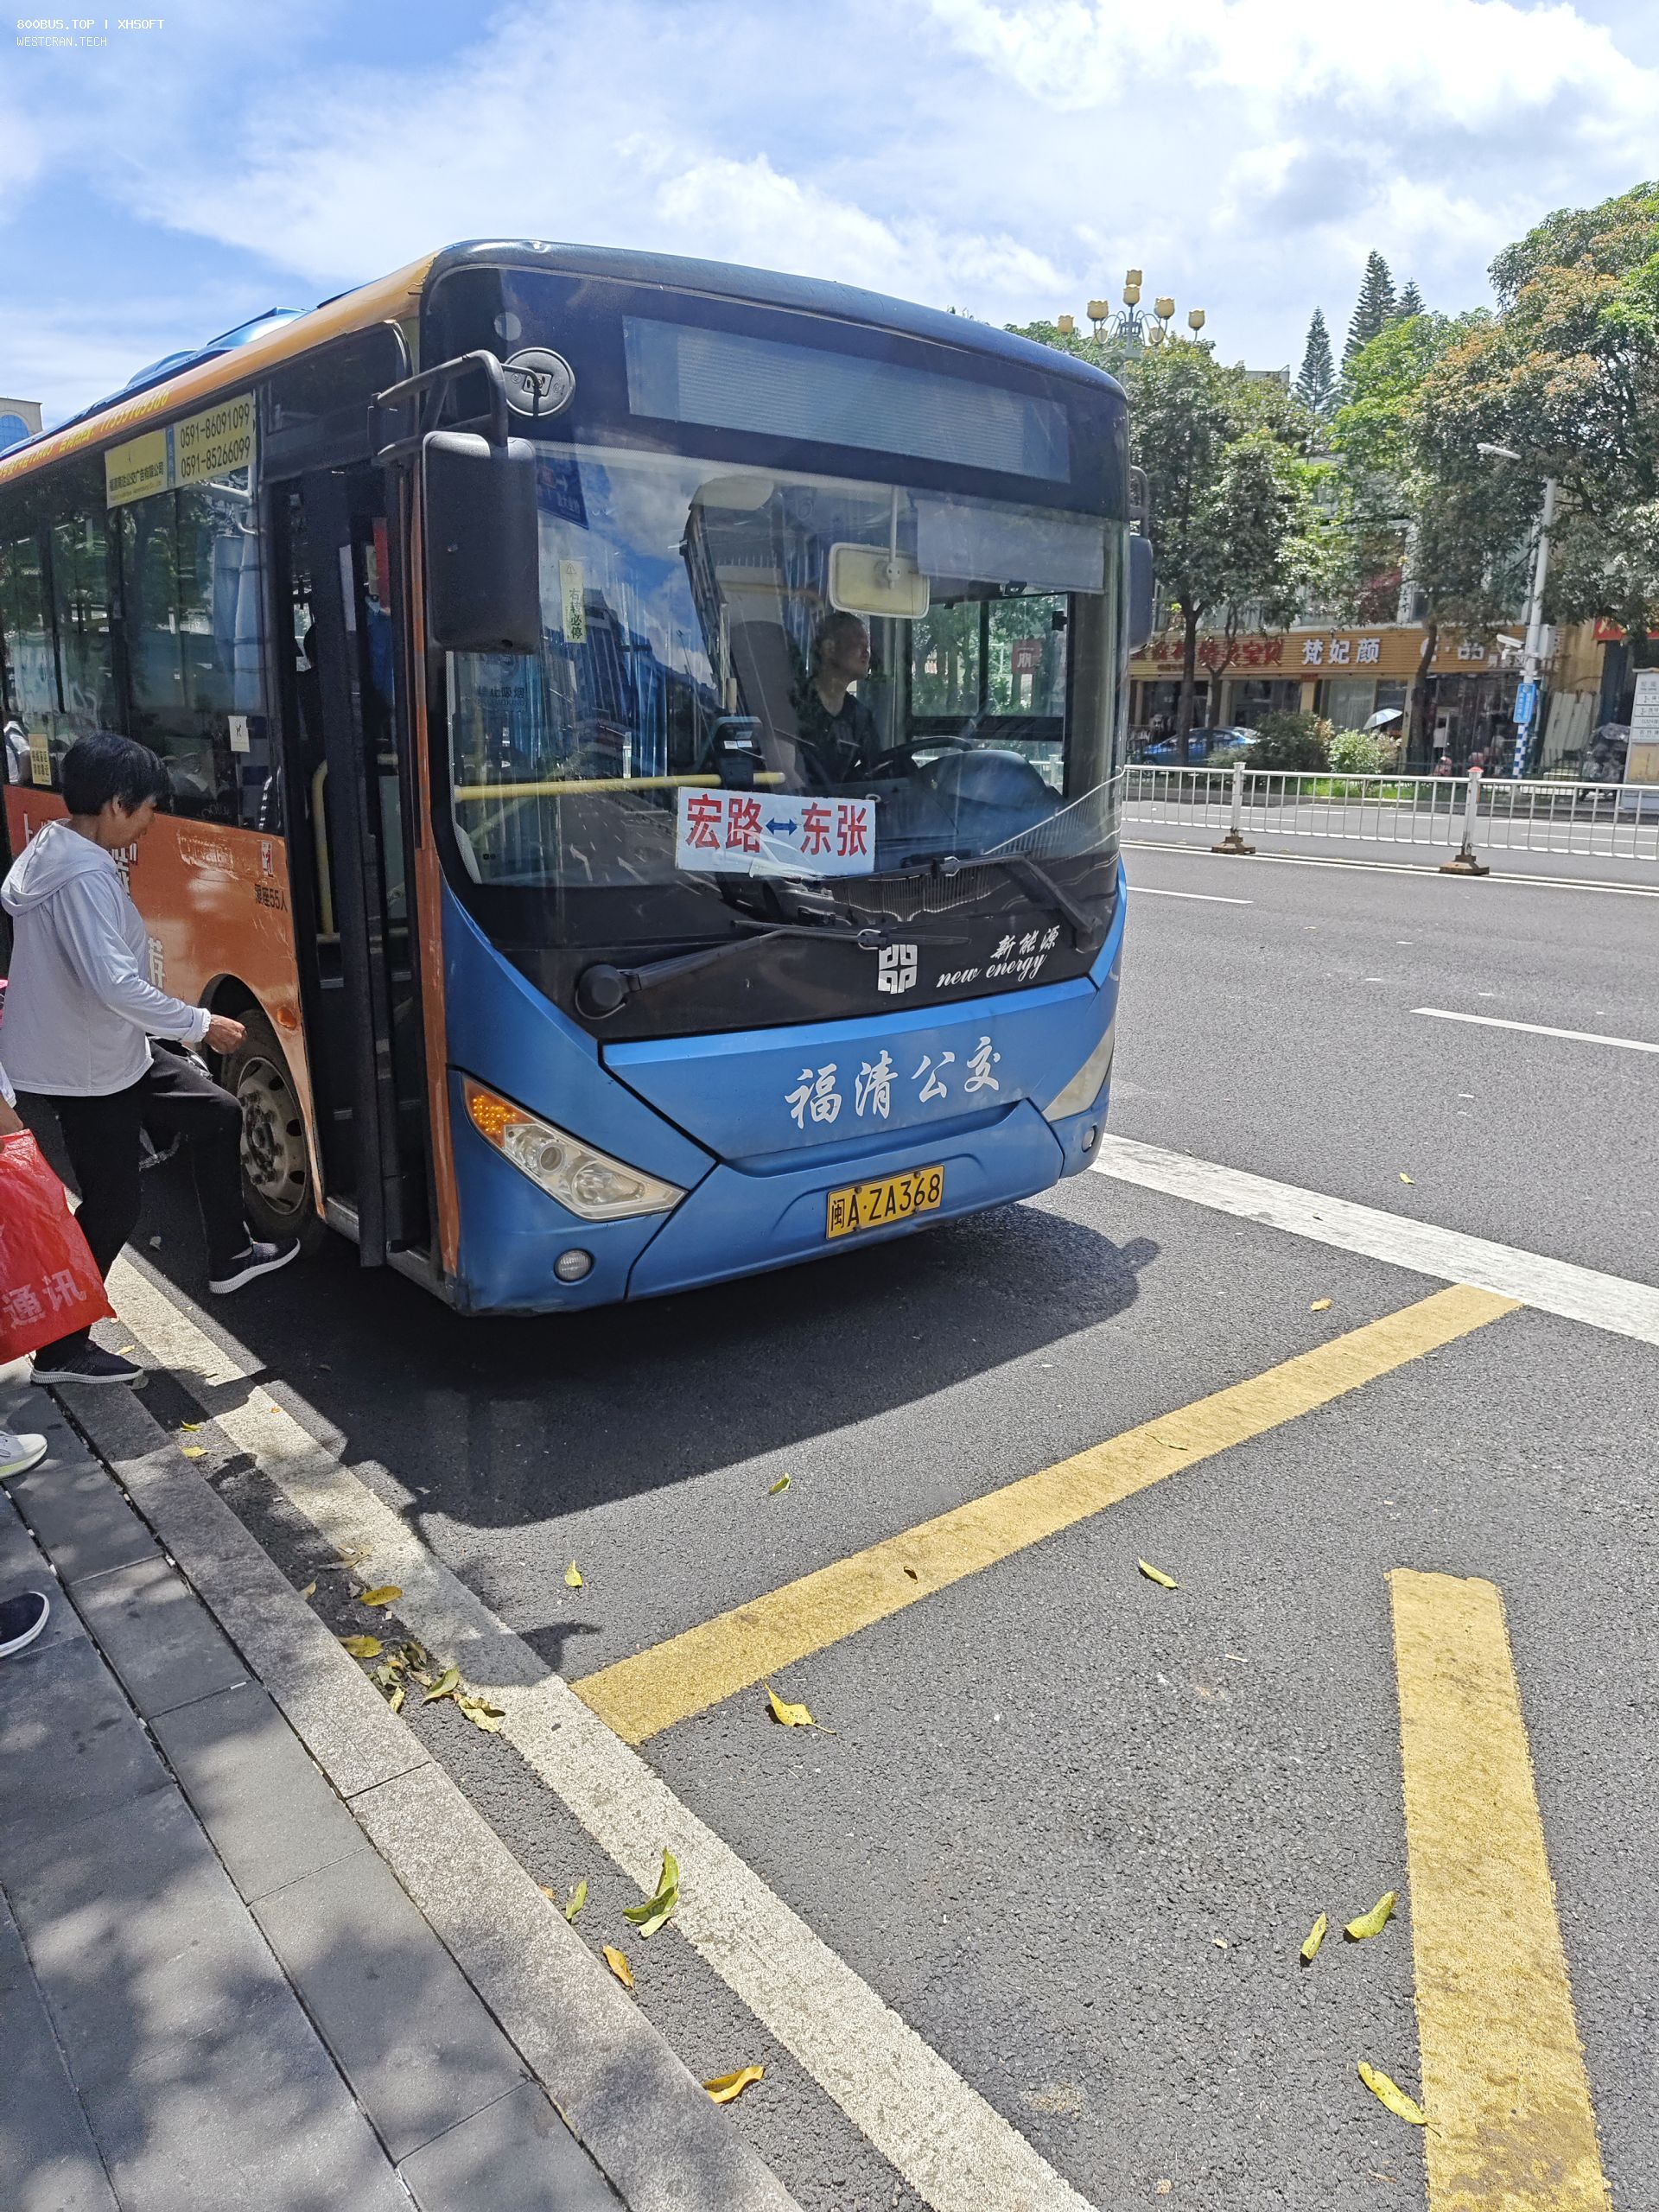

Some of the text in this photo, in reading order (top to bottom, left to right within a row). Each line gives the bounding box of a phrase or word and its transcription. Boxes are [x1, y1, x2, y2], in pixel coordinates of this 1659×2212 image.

[180, 403, 250, 448] 0591-86091099
[181, 435, 251, 478] 0591-85266099
[569, 588, 583, 639] 右转必停
[1301, 637, 1381, 665] 梵妃颜
[685, 793, 868, 857] 宏路 东张
[989, 925, 1060, 960] 新能源
[936, 954, 1048, 988] new energy
[785, 1036, 1001, 1129] 福清公交
[2, 1268, 87, 1330] 通讯
